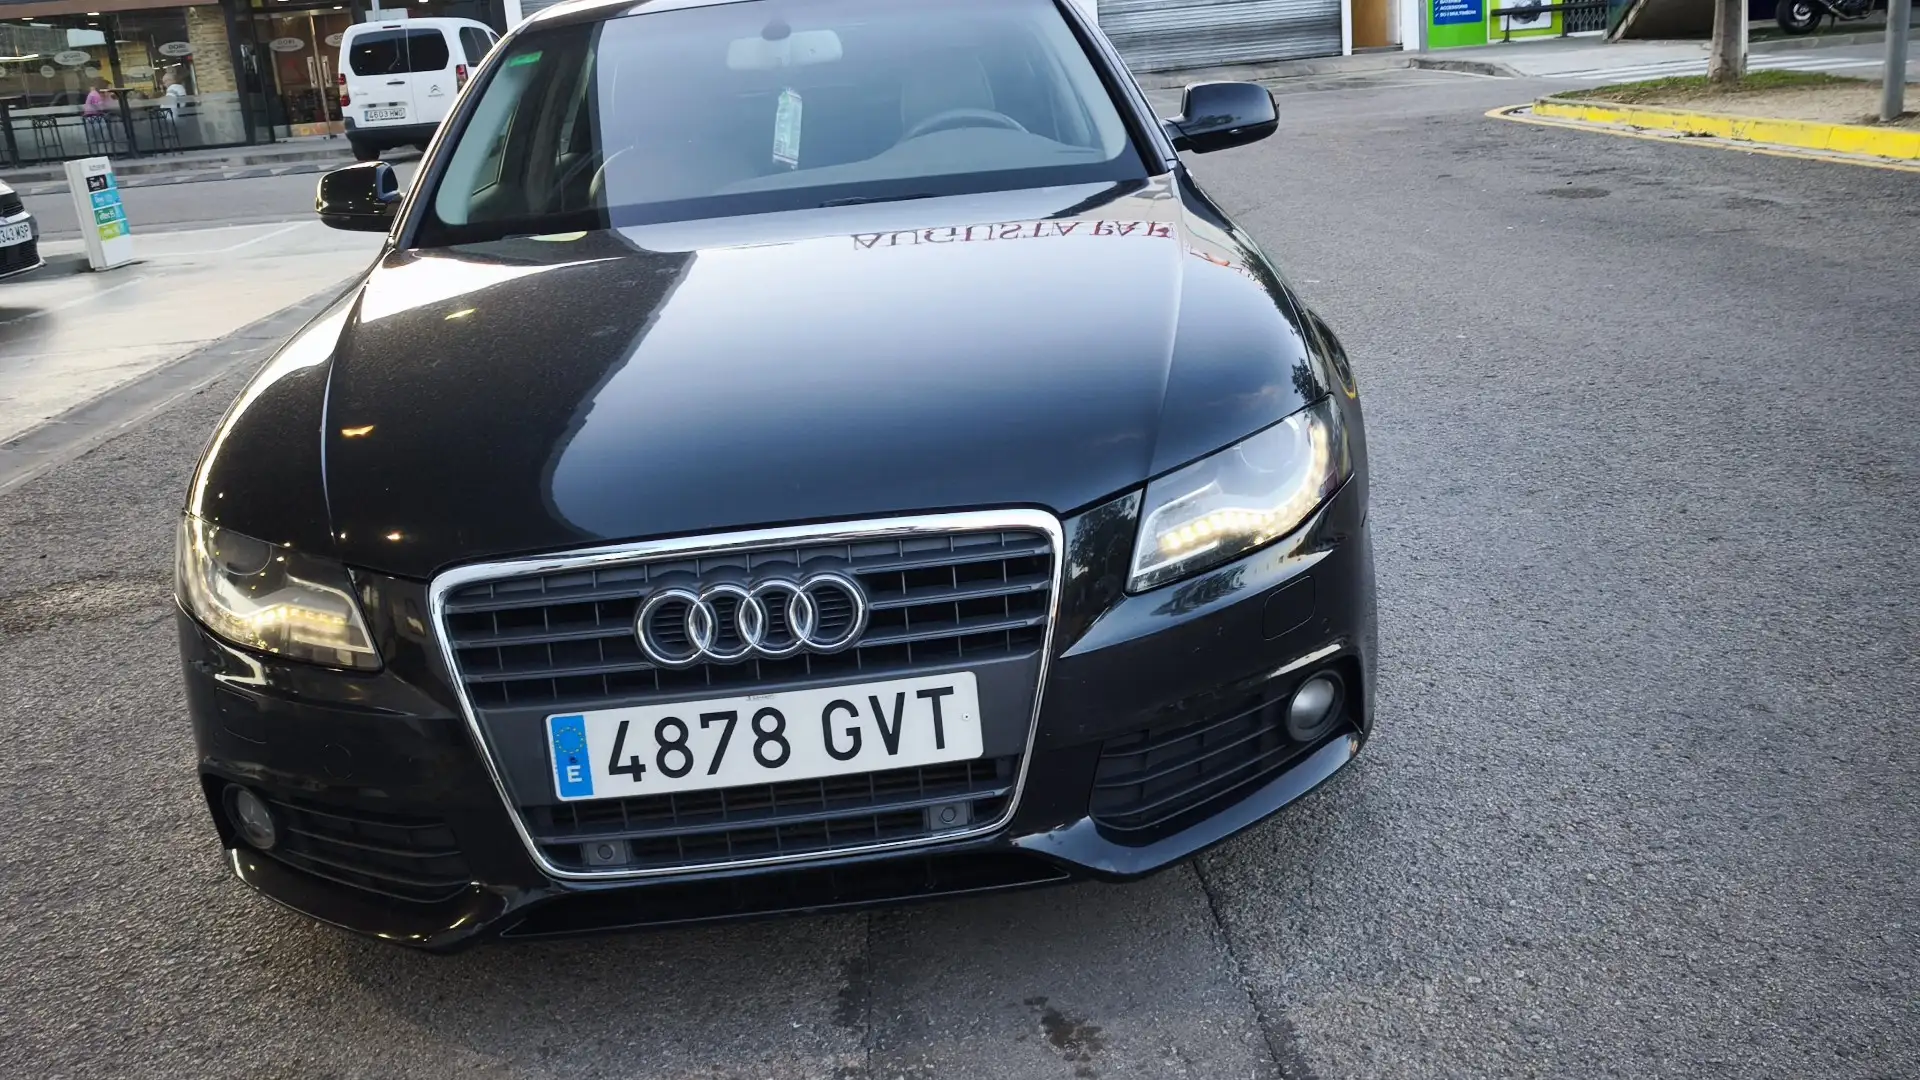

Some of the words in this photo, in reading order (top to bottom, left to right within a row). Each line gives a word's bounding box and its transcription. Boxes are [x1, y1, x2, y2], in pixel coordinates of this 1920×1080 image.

[0, 226, 14, 243] 343
[566, 764, 583, 783] E
[608, 706, 791, 783] 4878
[821, 685, 955, 762] GVT
